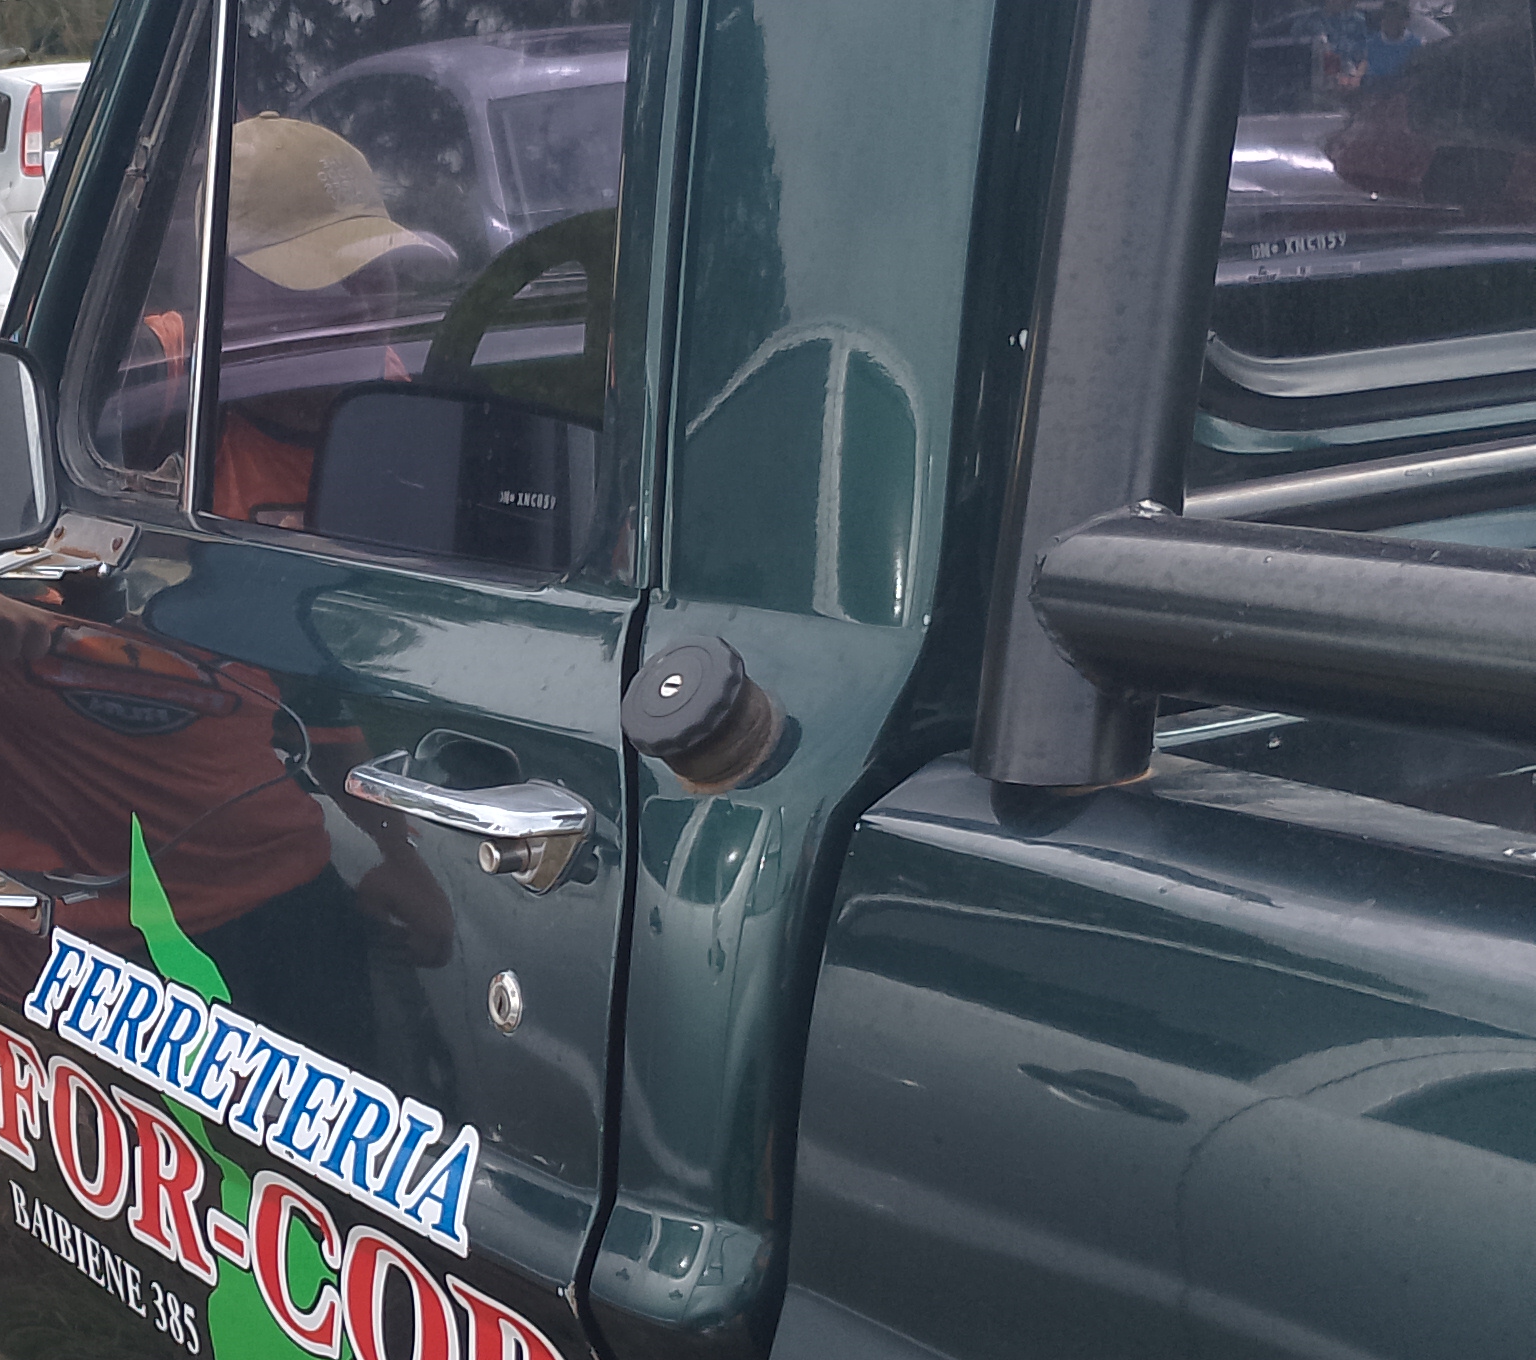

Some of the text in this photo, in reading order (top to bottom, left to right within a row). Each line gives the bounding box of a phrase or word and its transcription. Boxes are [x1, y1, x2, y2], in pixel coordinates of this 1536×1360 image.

[24, 926, 480, 1257] FERRETERIA
[9, 1179, 201, 1357] BAIBIENE 385
